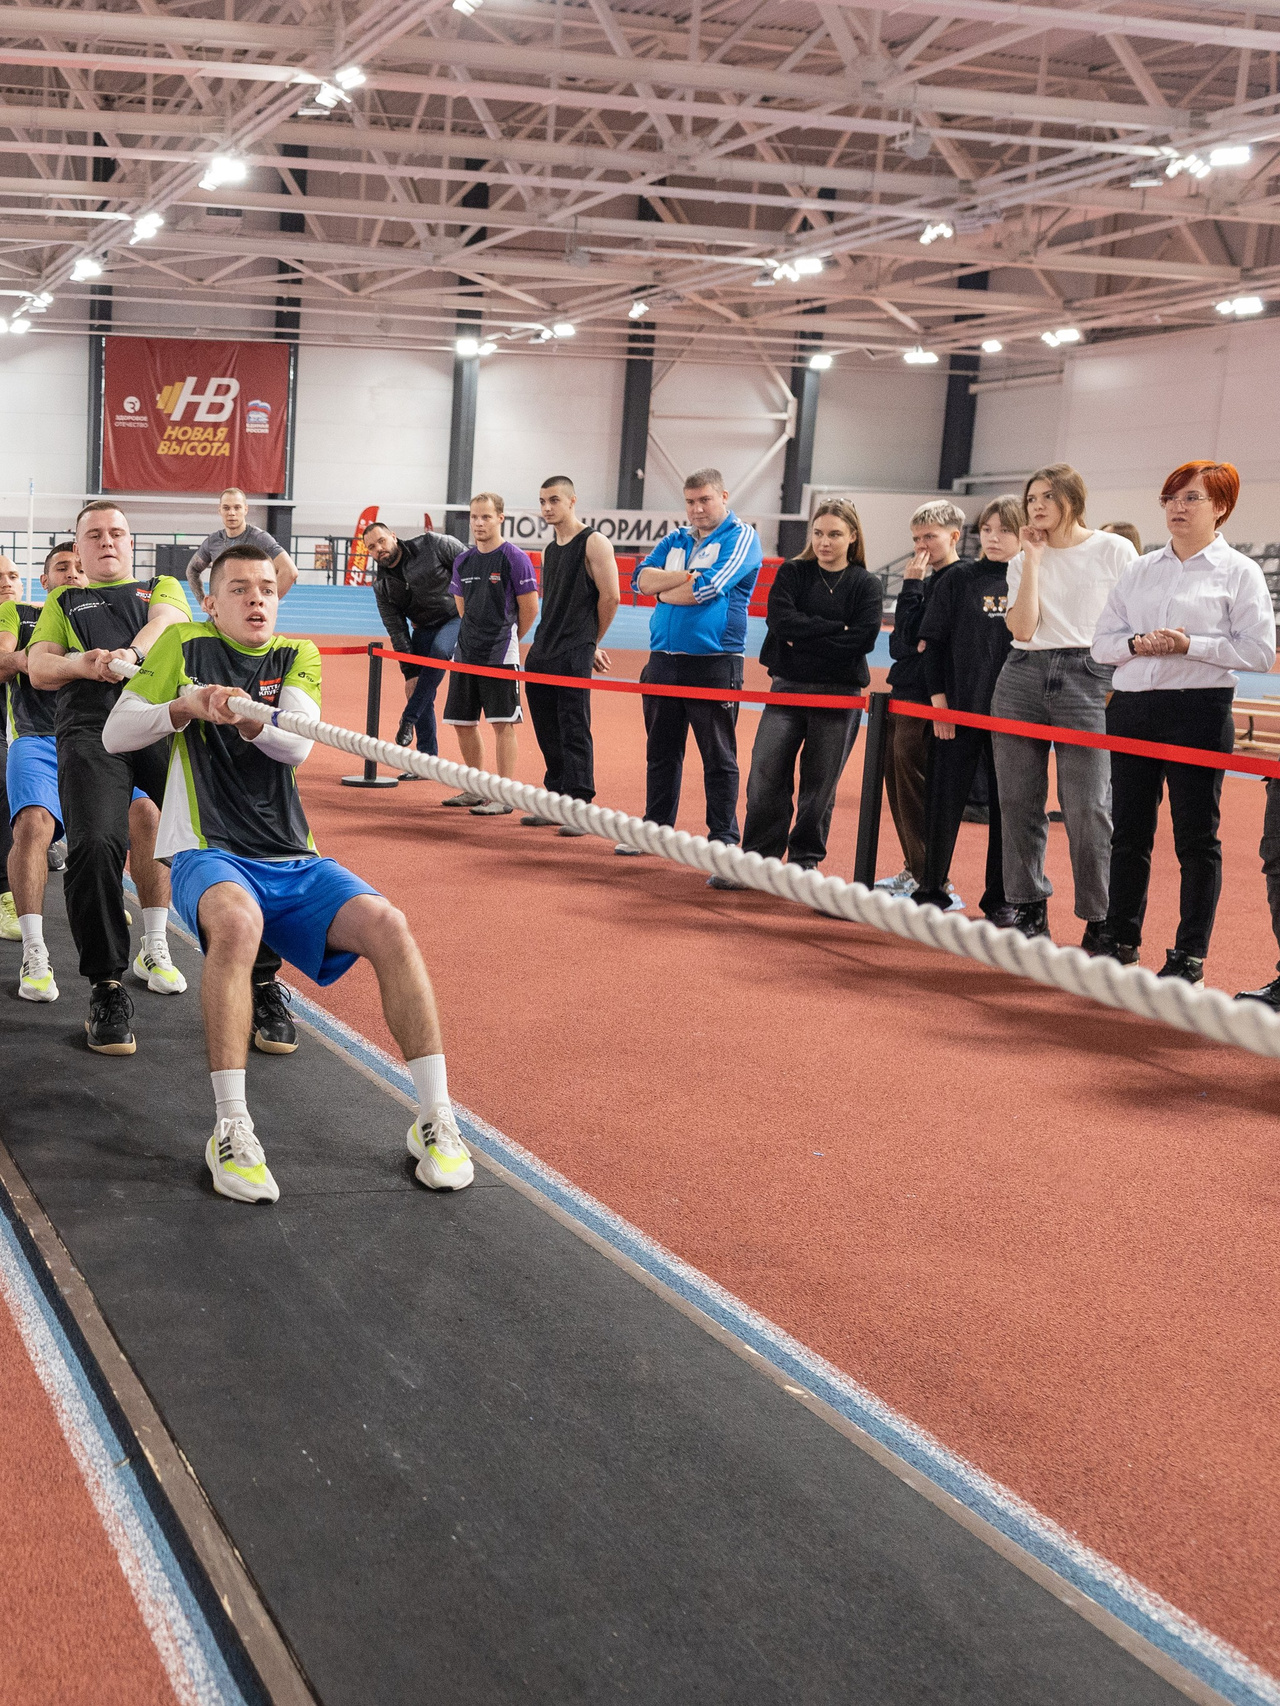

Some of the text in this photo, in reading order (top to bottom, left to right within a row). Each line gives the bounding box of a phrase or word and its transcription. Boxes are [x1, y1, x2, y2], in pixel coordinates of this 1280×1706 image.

[170, 376, 240, 423] НВ
[163, 426, 228, 441] НОВАЯ
[157, 441, 230, 456] ВЫСОТА
